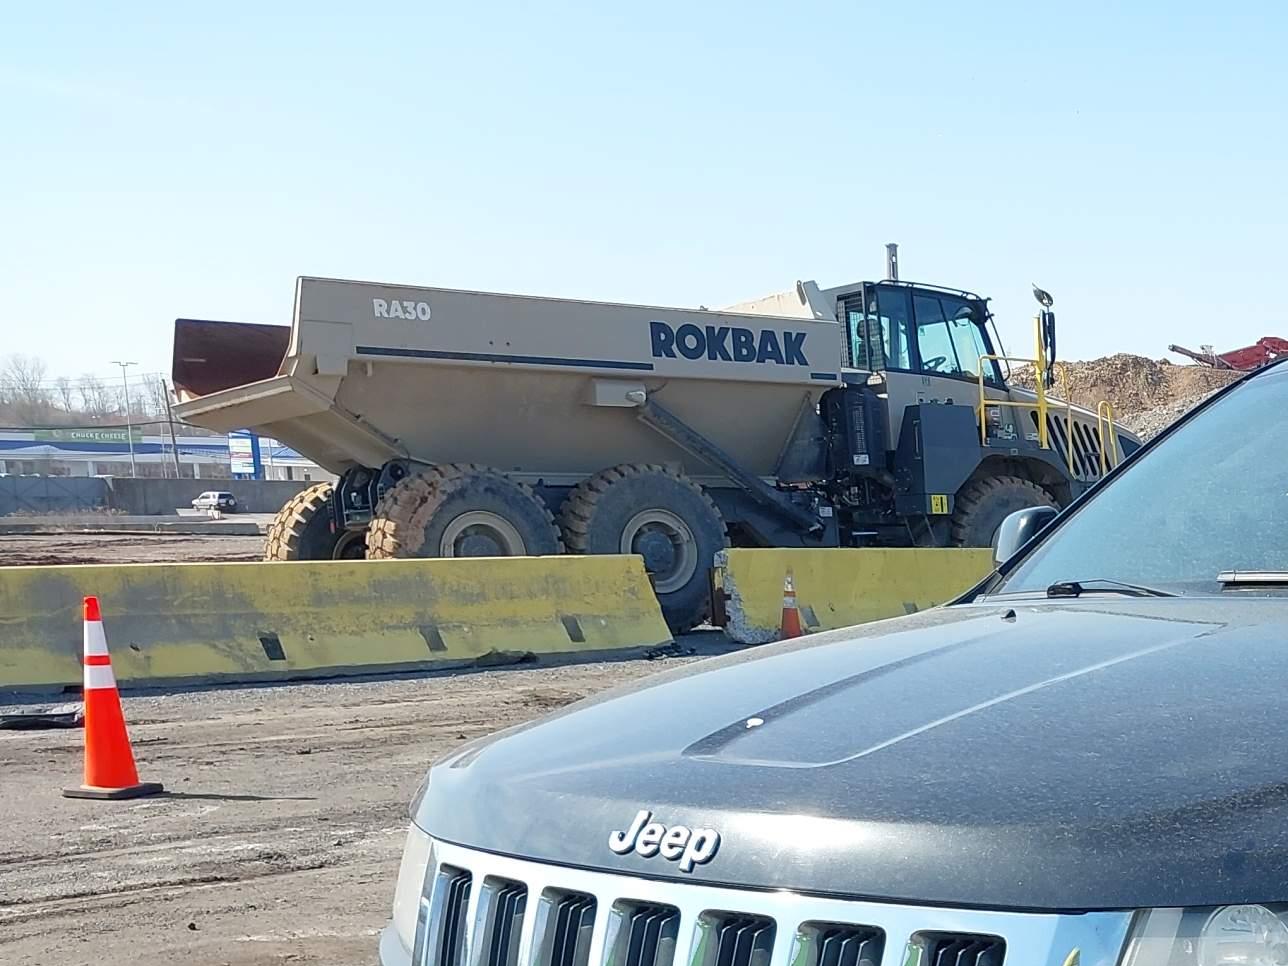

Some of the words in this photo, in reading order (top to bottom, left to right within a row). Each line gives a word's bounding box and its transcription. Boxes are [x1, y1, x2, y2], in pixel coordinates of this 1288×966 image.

[373, 298, 431, 321] RA30
[649, 321, 809, 366] ROKBAK
[71, 431, 94, 440] CHUCK
[608, 810, 721, 873] Jeep
